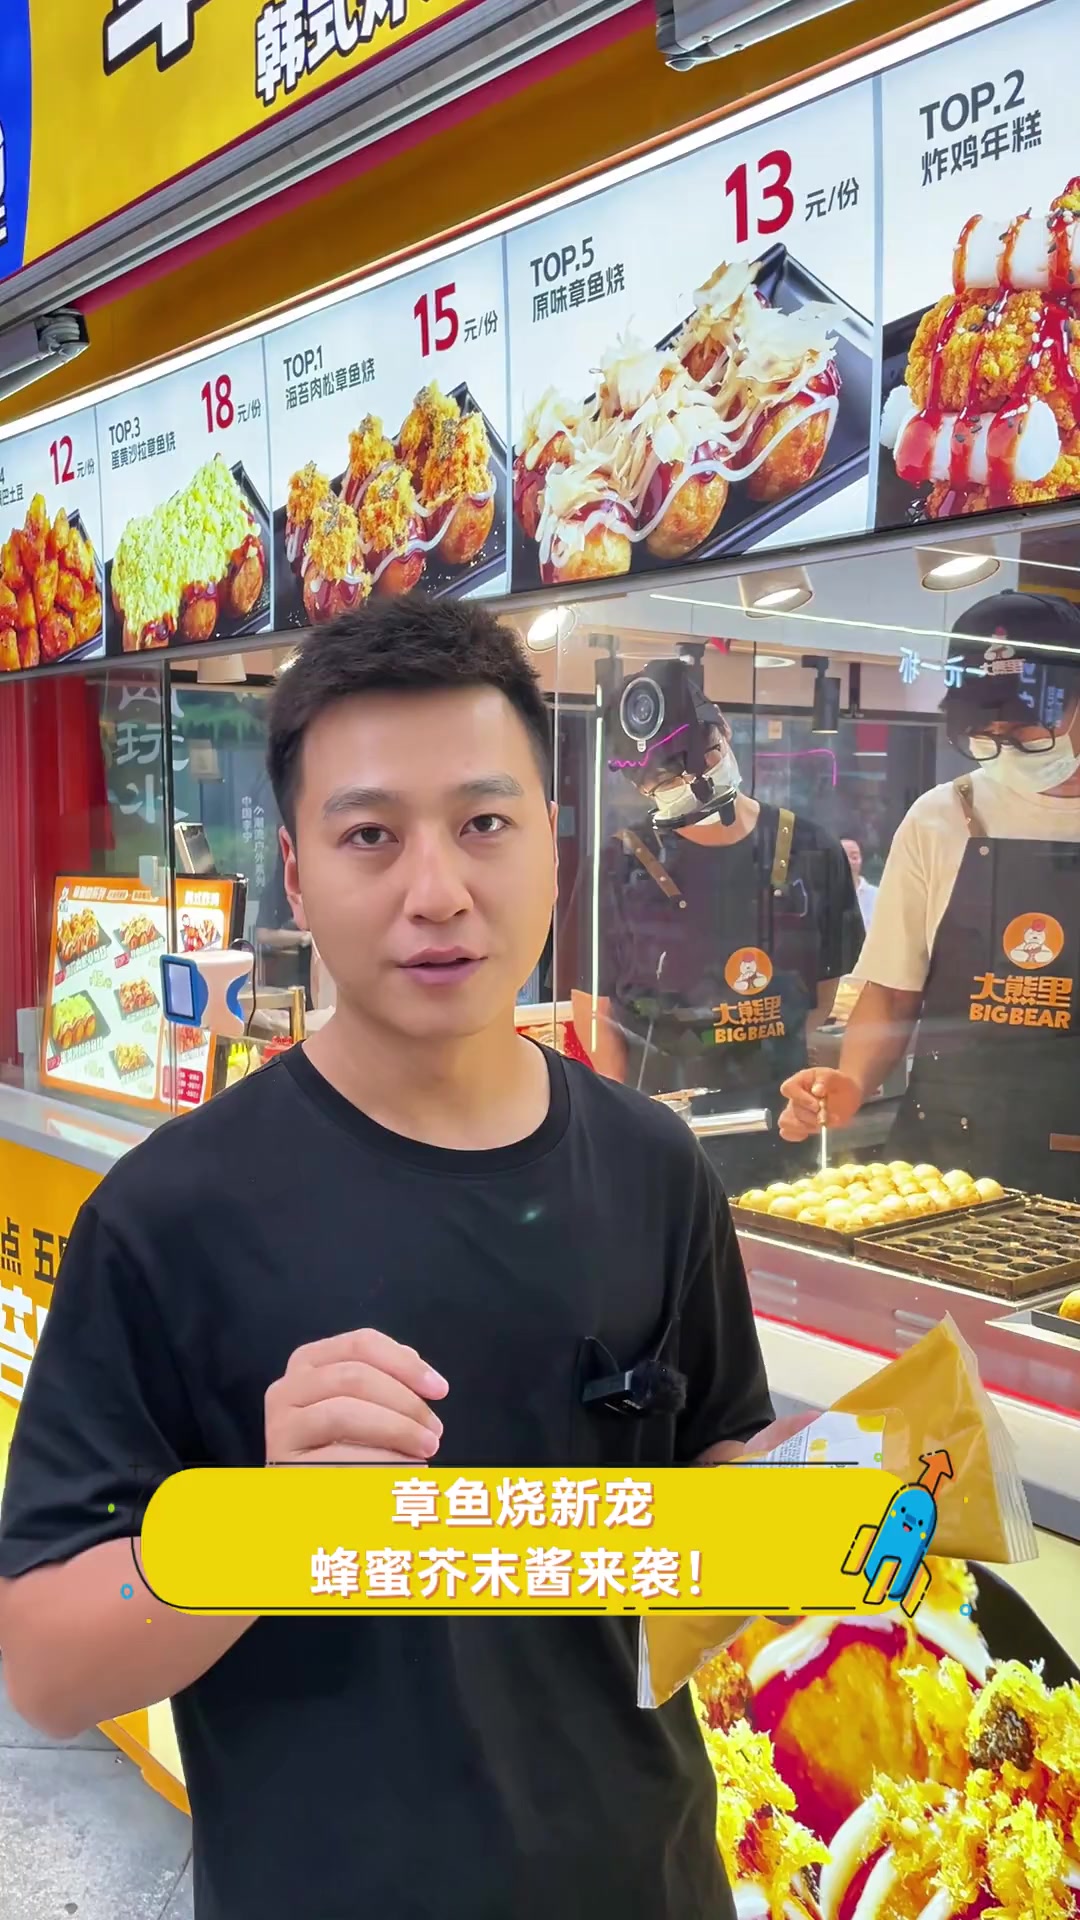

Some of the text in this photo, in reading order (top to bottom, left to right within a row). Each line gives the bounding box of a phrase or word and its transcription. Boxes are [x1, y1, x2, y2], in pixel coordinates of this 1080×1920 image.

[919, 69, 1026, 141] TOP.2
[921, 109, 1042, 187] 炸鸡年糕
[725, 149, 860, 244] 13 元/份
[530, 236, 595, 288] TOP.5
[532, 263, 625, 323] 原味章鱼烧
[413, 282, 499, 358] 15 元/份
[283, 345, 324, 382] TOP.1
[285, 357, 376, 411] 海苔肉松章鱼烧
[201, 374, 262, 434] 18 元/份
[108, 416, 141, 446] TOP.3
[111, 431, 177, 470] 蛋黄沙拉章鱼烧
[49, 435, 95, 486] 12 元/份
[0, 483, 24, 506] 巴土豆
[711, 994, 782, 1027] 大熊里
[969, 971, 1073, 1008] 大熊里
